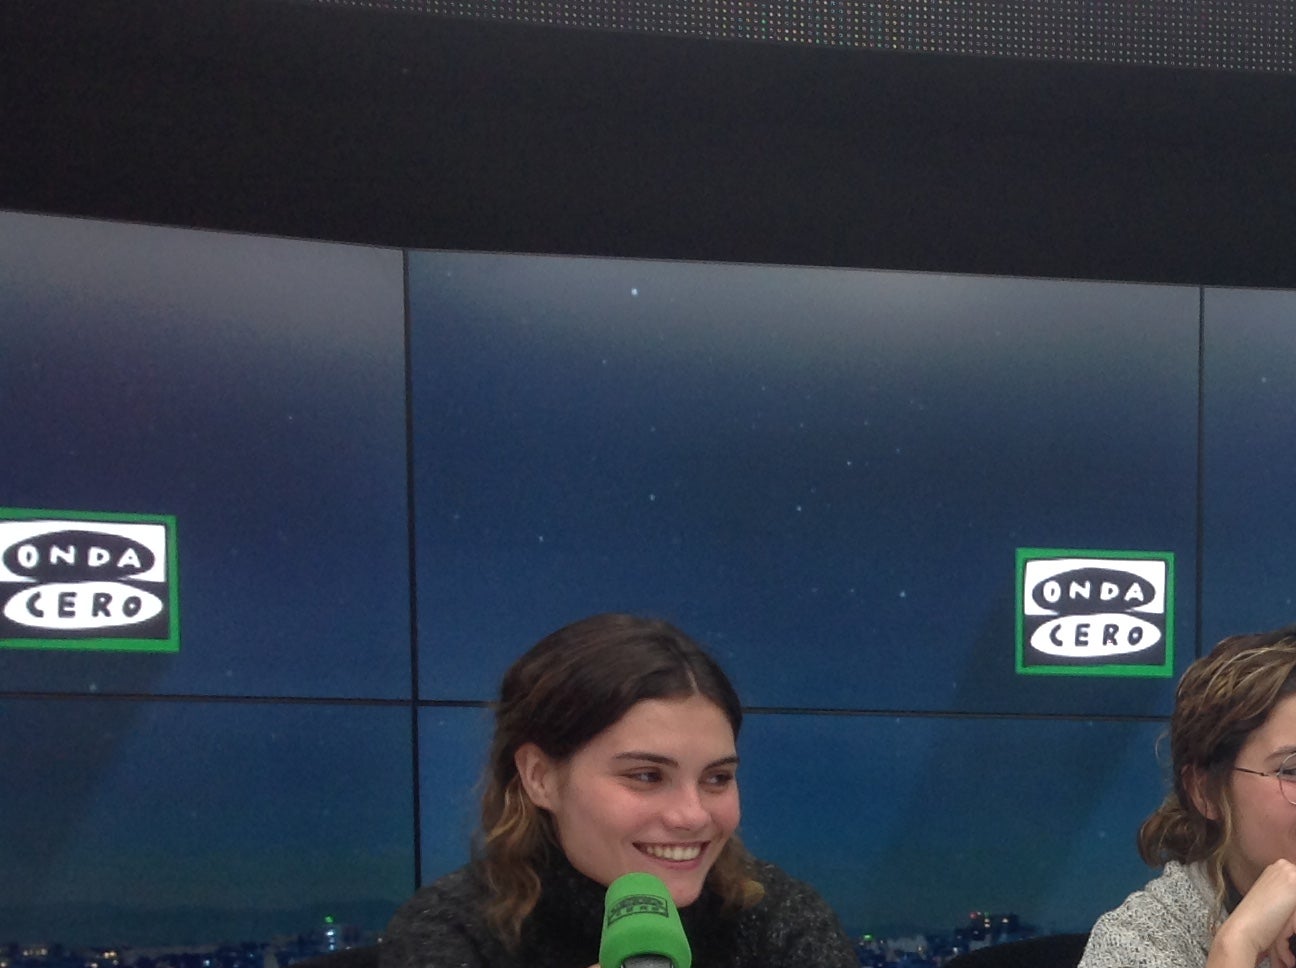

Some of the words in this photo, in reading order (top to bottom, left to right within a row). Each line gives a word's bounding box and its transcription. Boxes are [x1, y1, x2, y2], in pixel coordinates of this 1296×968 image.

[17, 544, 142, 569] ONDA
[1043, 580, 1144, 604] ONDA
[26, 591, 143, 618] CERO
[1049, 623, 1144, 647] CERO
